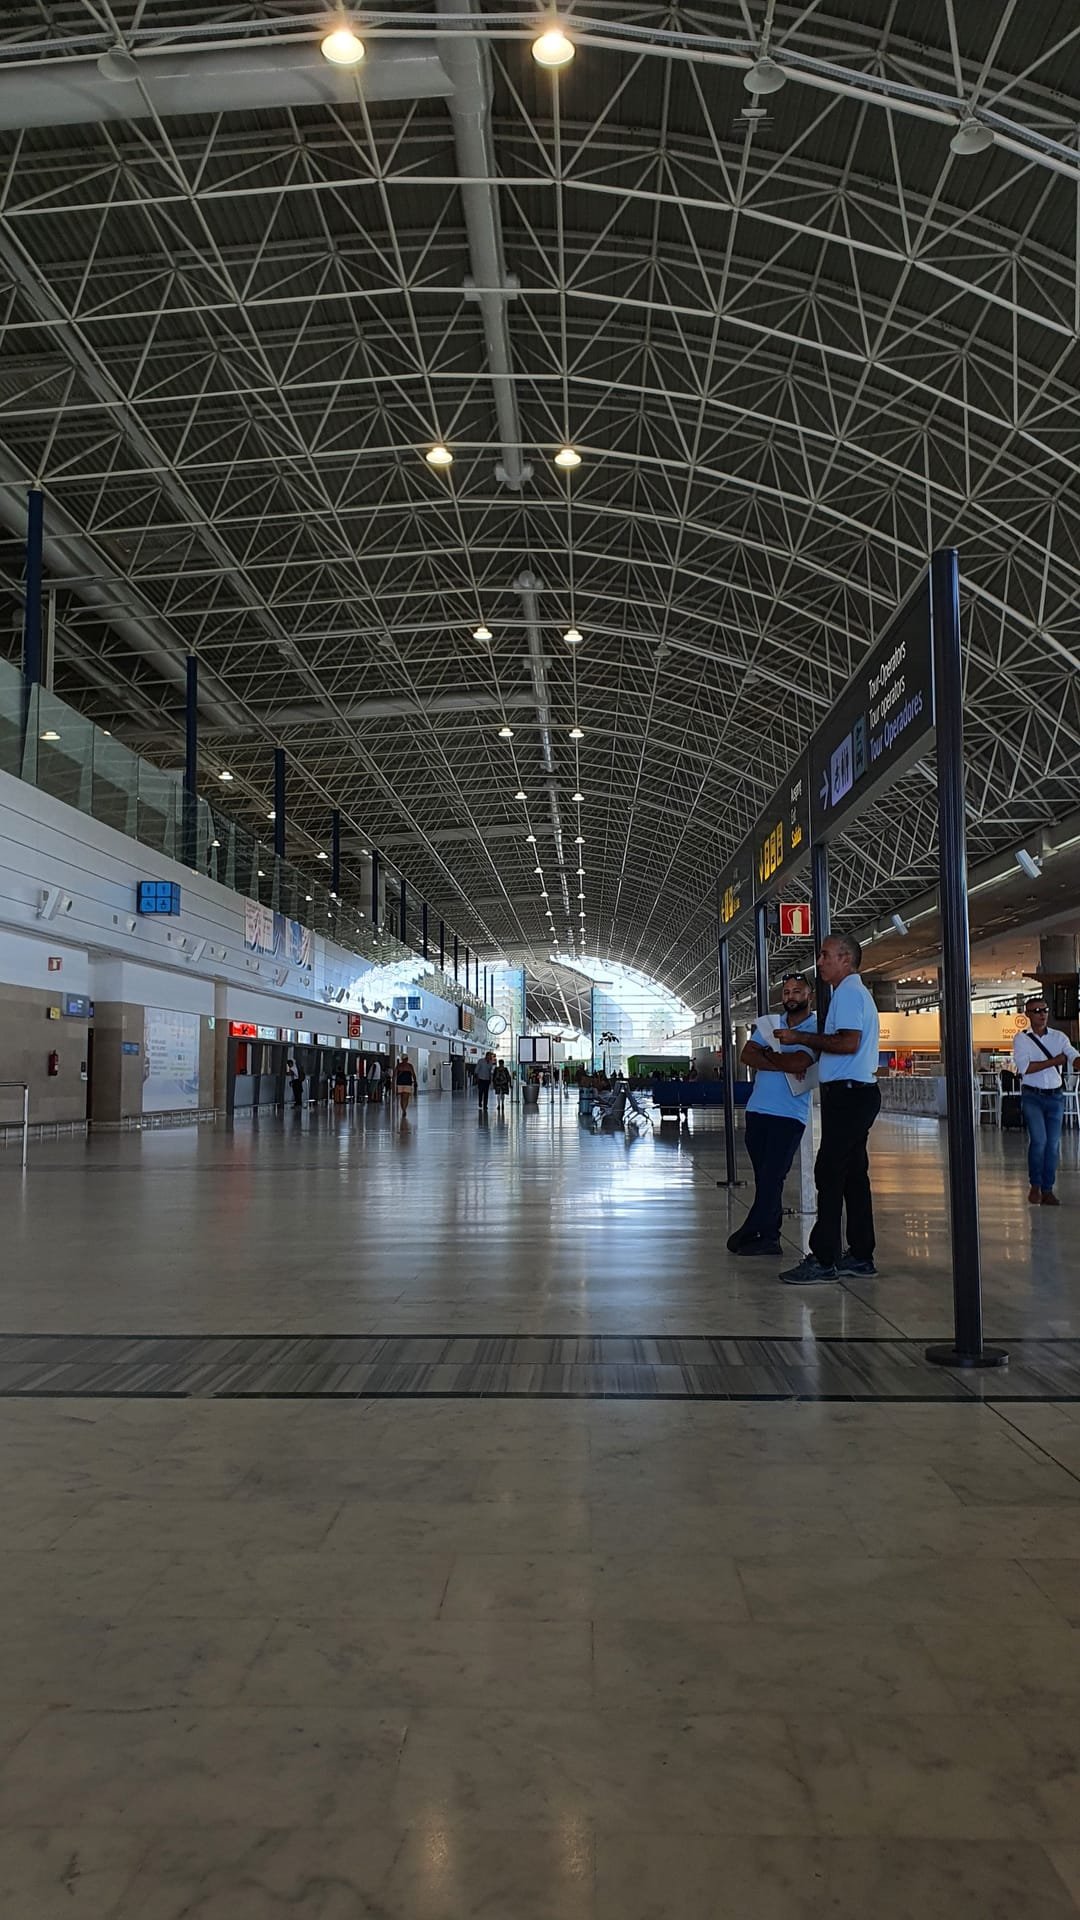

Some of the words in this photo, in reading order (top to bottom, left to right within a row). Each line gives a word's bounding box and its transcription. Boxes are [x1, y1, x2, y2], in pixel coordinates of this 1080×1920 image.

[868, 640, 906, 700] Tour-Operators
[869, 705, 880, 730] Tour
[881, 675, 905, 719] operators
[870, 734, 883, 761] Tour
[884, 689, 923, 749] Operadores
